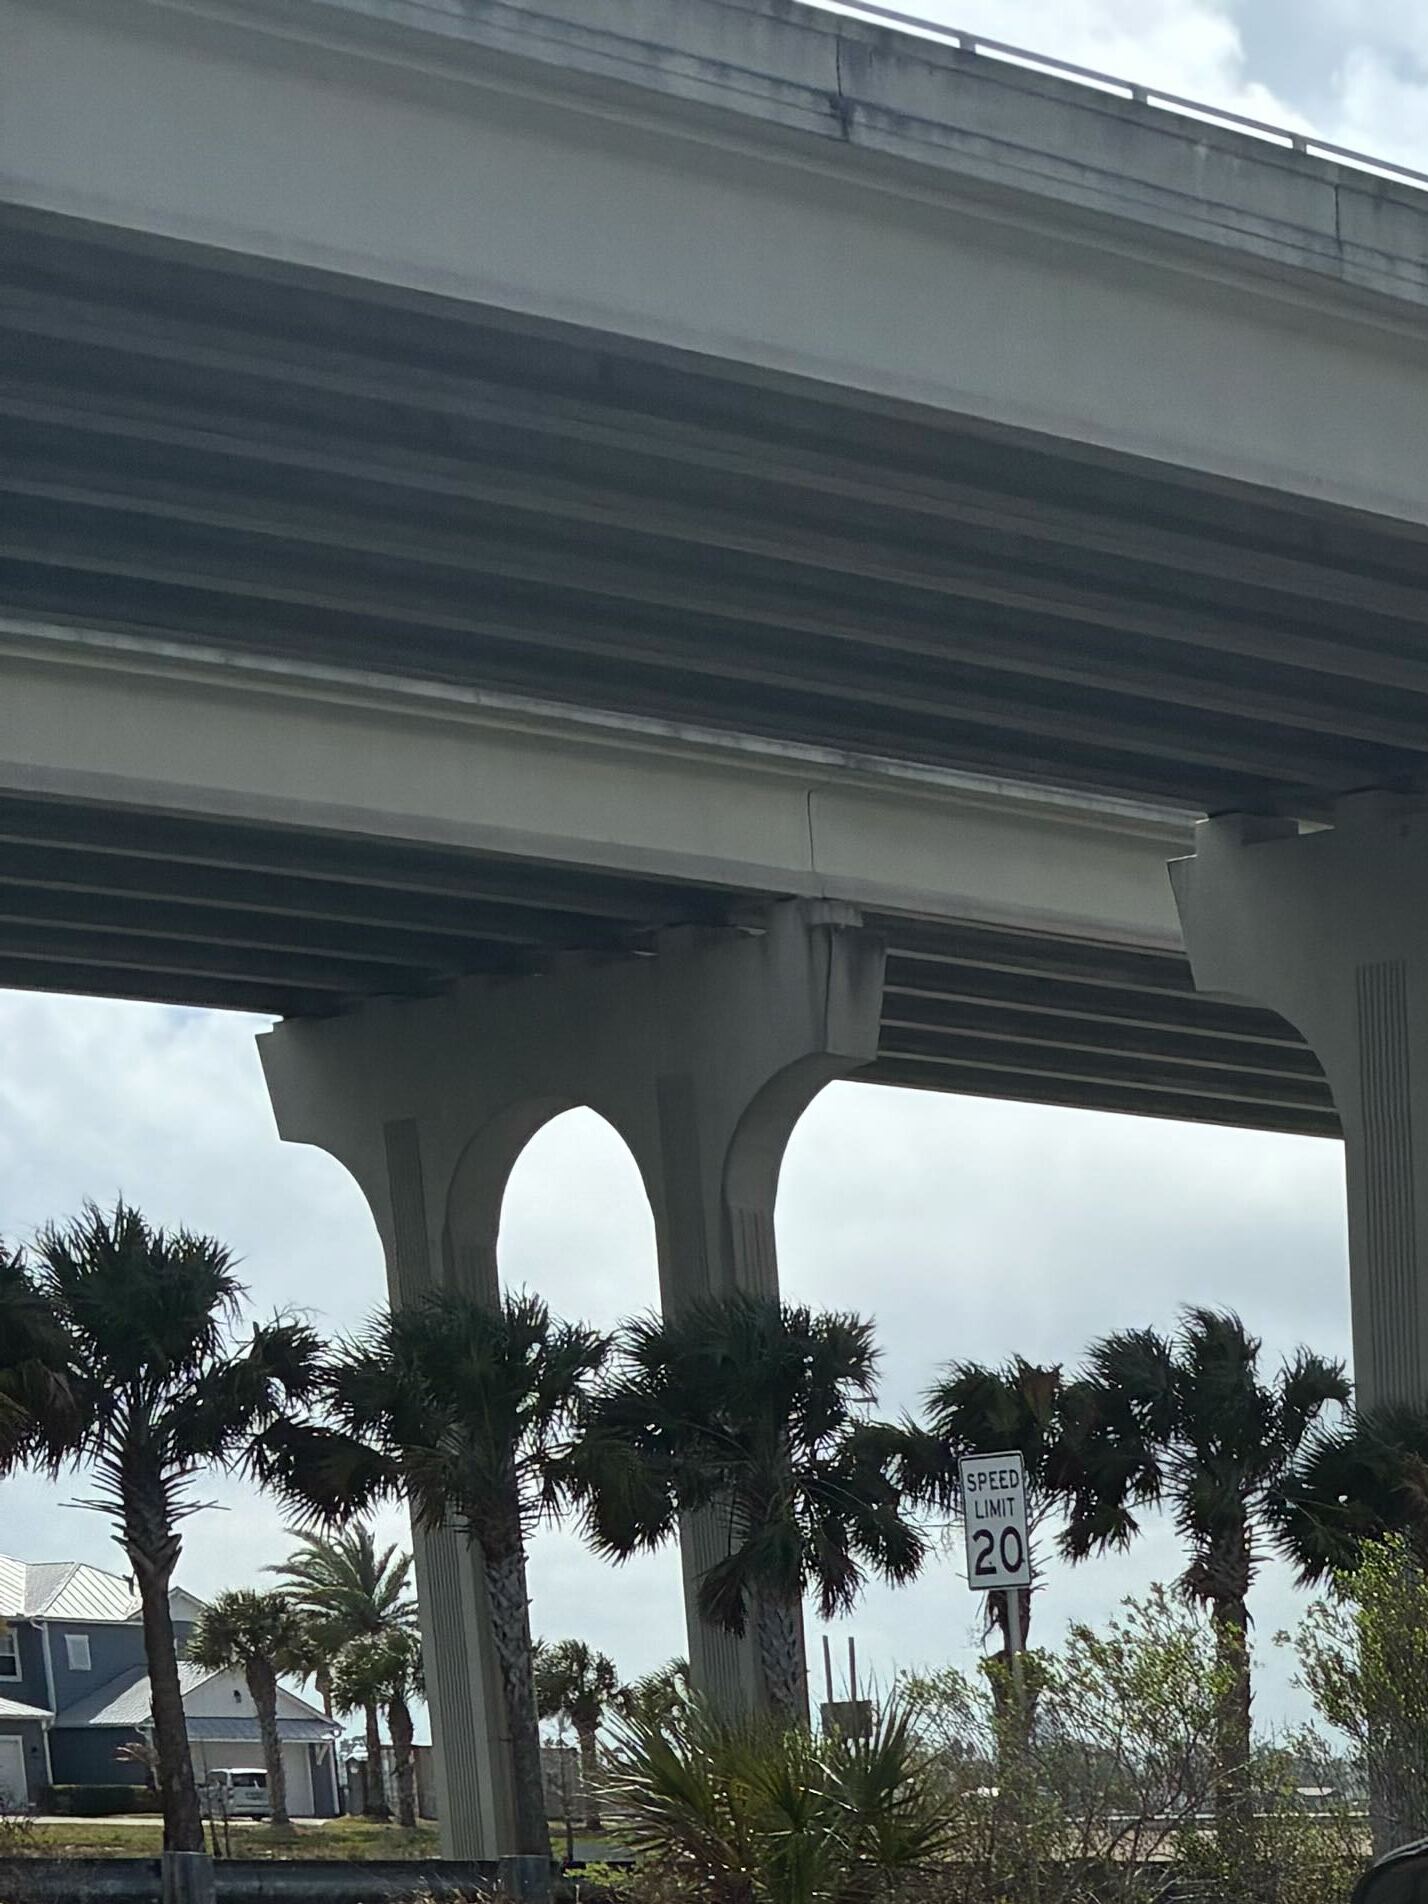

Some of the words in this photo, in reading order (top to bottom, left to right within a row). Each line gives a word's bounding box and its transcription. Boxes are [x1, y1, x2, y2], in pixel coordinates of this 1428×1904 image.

[967, 1469, 1019, 1492] SPEED
[975, 1498, 1015, 1519] LIMIT
[973, 1526, 1023, 1576] 20
